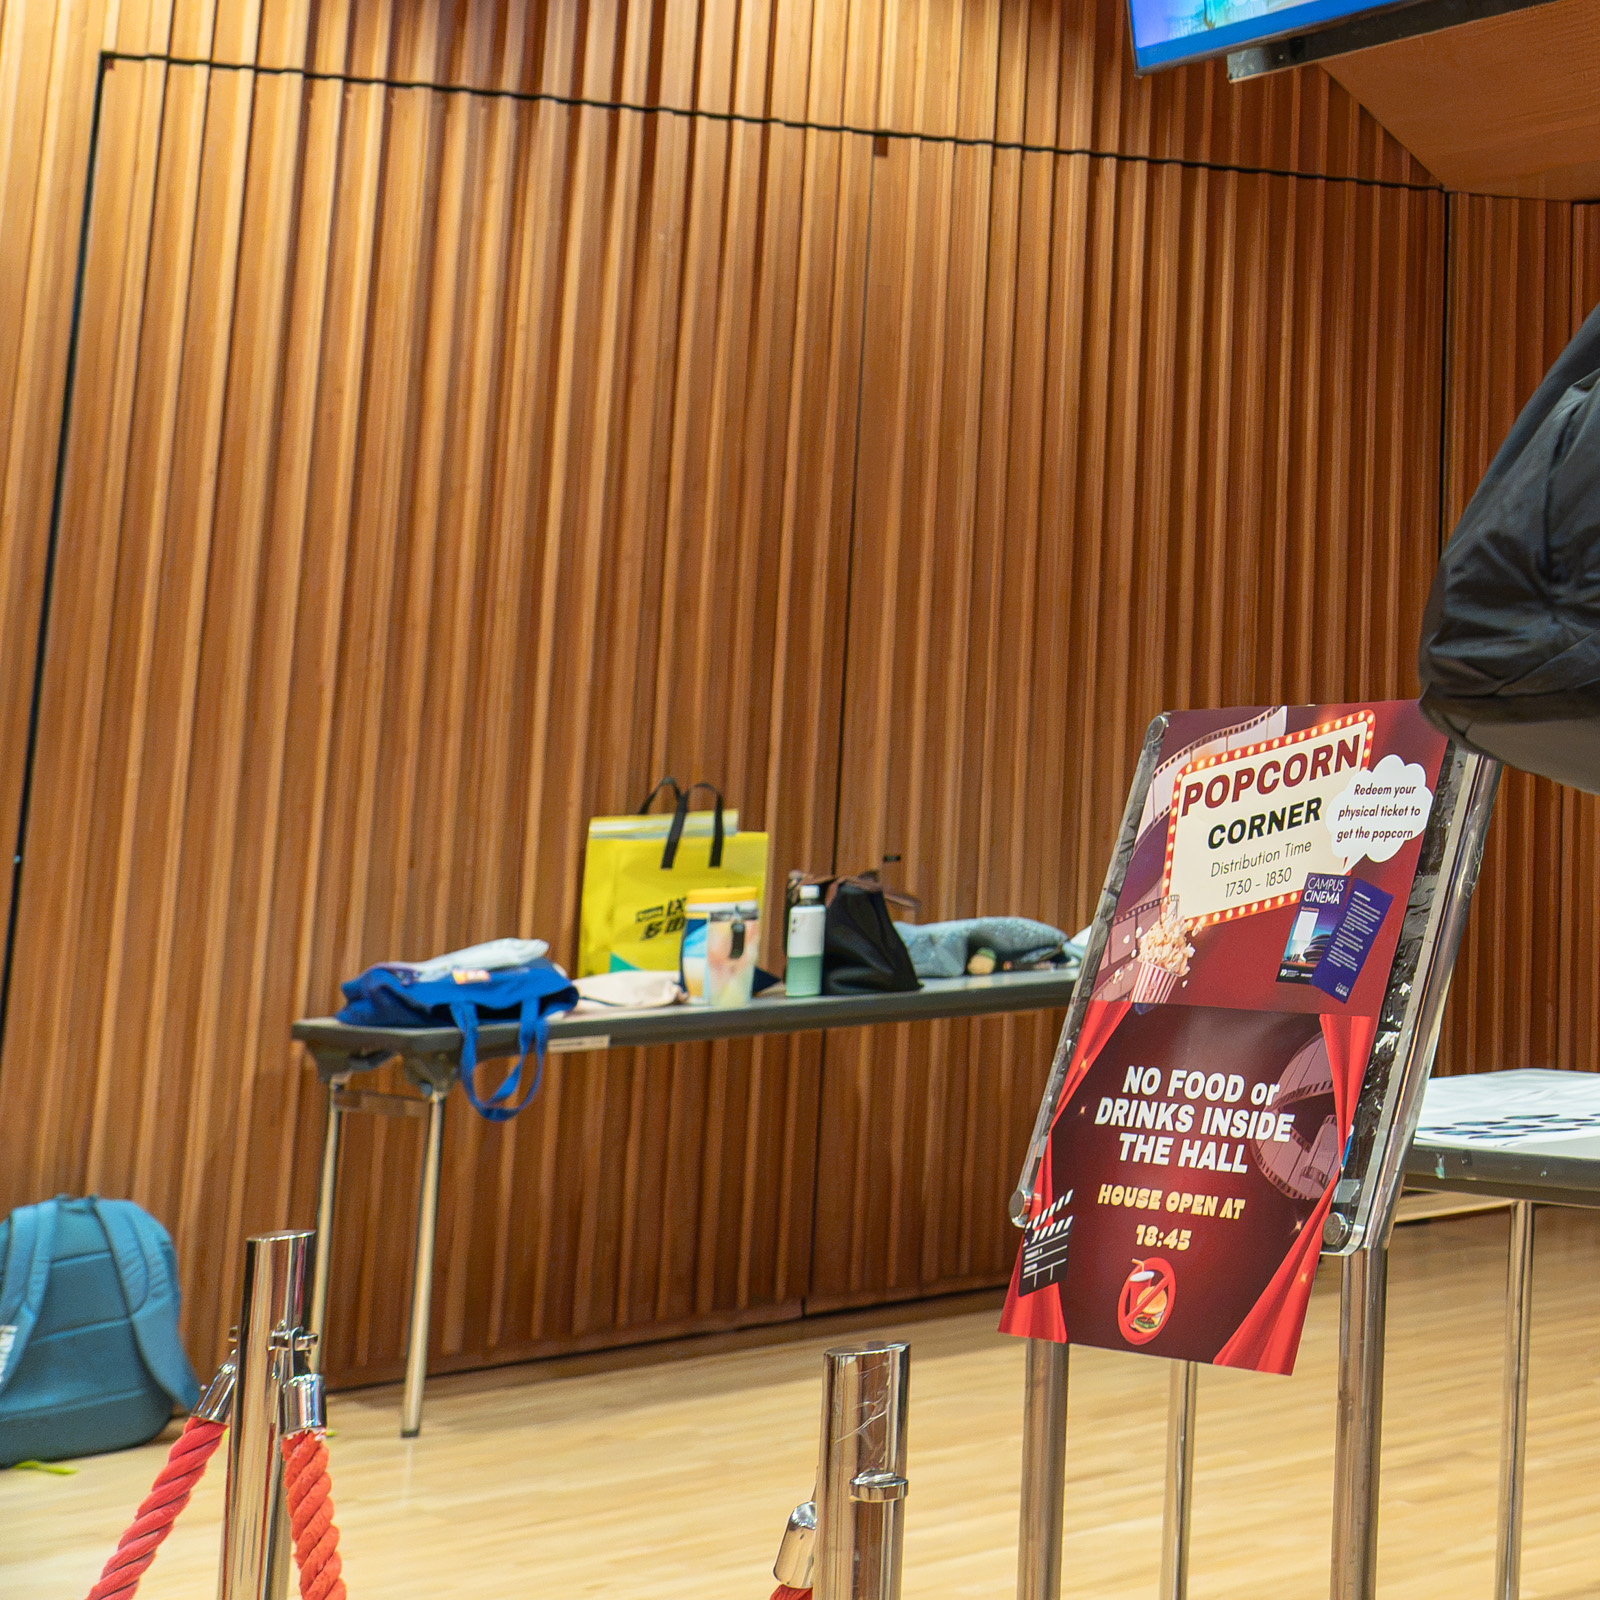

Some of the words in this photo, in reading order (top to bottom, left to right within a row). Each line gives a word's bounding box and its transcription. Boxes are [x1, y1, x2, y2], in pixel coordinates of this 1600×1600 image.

[1181, 734, 1360, 817] POPCORN
[1354, 784, 1392, 796] Redeem
[1394, 785, 1417, 798] your
[1208, 797, 1323, 850] CORNER
[1338, 805, 1379, 820] physical
[1381, 805, 1409, 818] ticket
[1411, 806, 1421, 817] to
[1337, 830, 1353, 842] get
[1355, 828, 1370, 840] the
[1372, 830, 1413, 842] popcorn
[1211, 850, 1280, 877] Distribution
[1285, 840, 1312, 858] Time
[1225, 878, 1252, 898] 1730
[1266, 867, 1292, 887] 1830
[1304, 890, 1340, 905] CINEMA
[1308, 877, 1345, 892] CAMPUS
[1122, 1065, 1162, 1096] NO
[1167, 1069, 1245, 1103] FOOD
[1250, 1082, 1280, 1106] or
[1094, 1097, 1195, 1133] DRINKS
[1200, 1106, 1295, 1143] INSIDE
[1119, 1132, 1174, 1166] THE
[1177, 1139, 1248, 1174] HALL
[1097, 1183, 1163, 1210] HOUSE
[1165, 1191, 1219, 1218] OPEN
[1219, 1198, 1246, 1220] AT
[1136, 1224, 1192, 1251] 18:45
